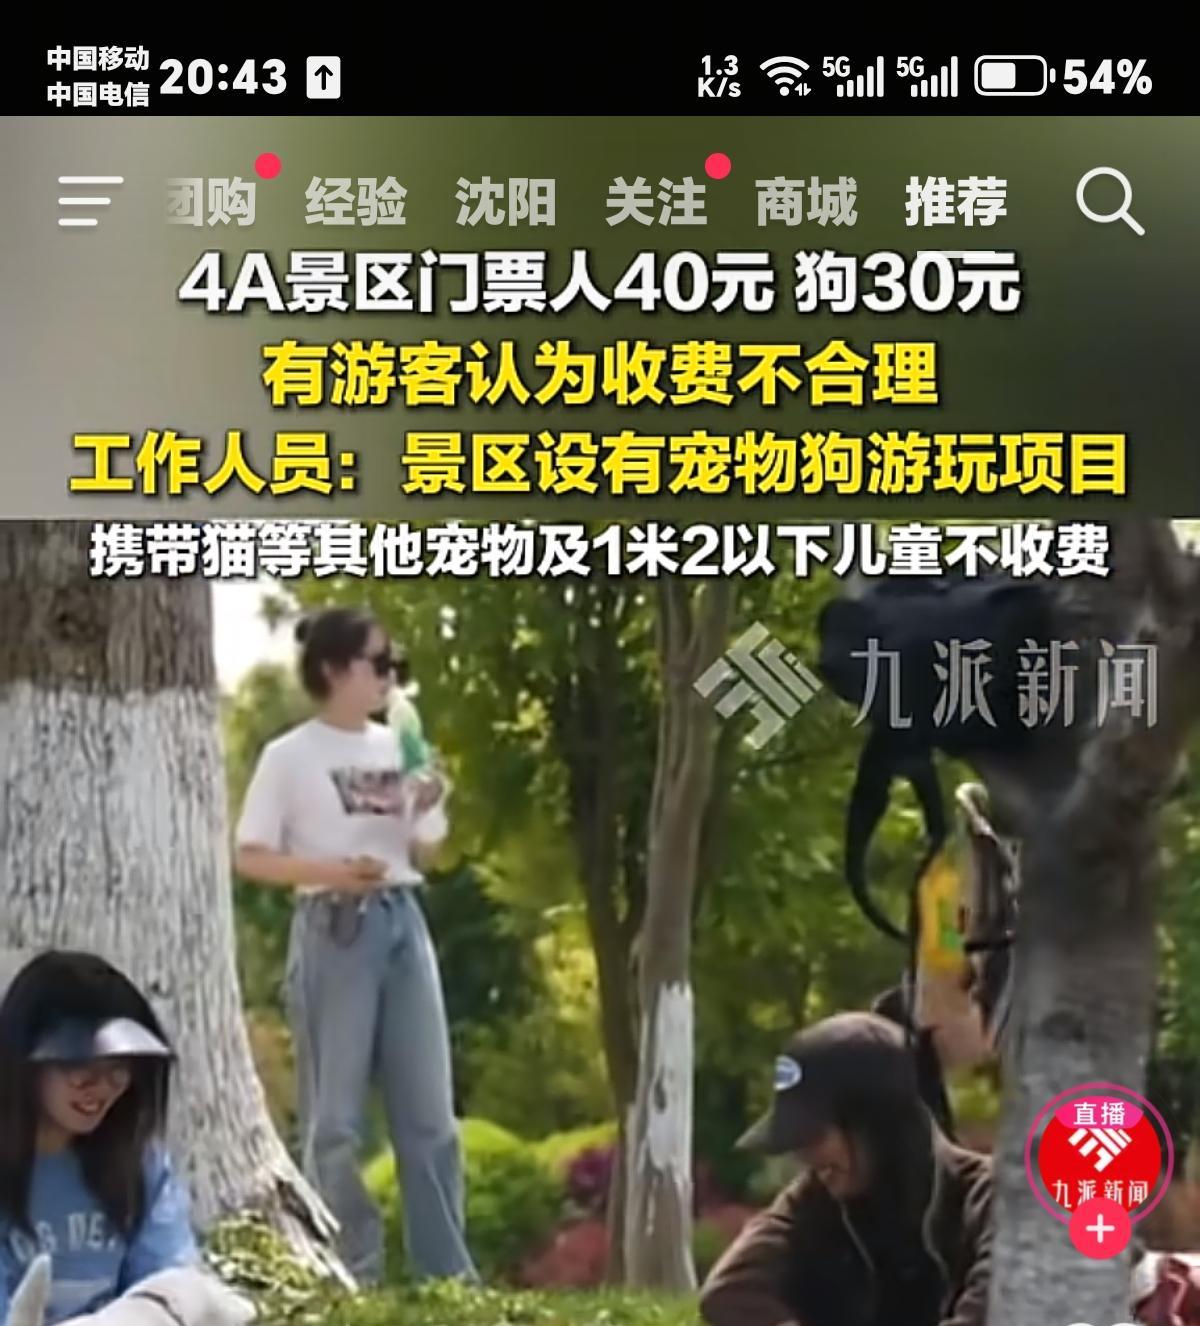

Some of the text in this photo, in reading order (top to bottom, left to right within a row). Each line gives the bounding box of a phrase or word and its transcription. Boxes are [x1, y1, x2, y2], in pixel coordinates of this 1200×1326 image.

[47, 45, 150, 72] 中国移动
[700, 54, 739, 76] 1.3
[822, 55, 851, 78] 5G
[896, 55, 925, 78] 5G
[159, 58, 287, 95] 20:43
[697, 77, 742, 98] K/s
[1063, 58, 1153, 95] 54%
[47, 81, 150, 108] 中国电信
[305, 176, 408, 227] 经验
[456, 176, 557, 227] 沈阳
[605, 176, 708, 227] 关注
[755, 176, 858, 227] 商城
[905, 175, 1007, 227] 推荐
[1074, 1102, 1125, 1125] 直播
